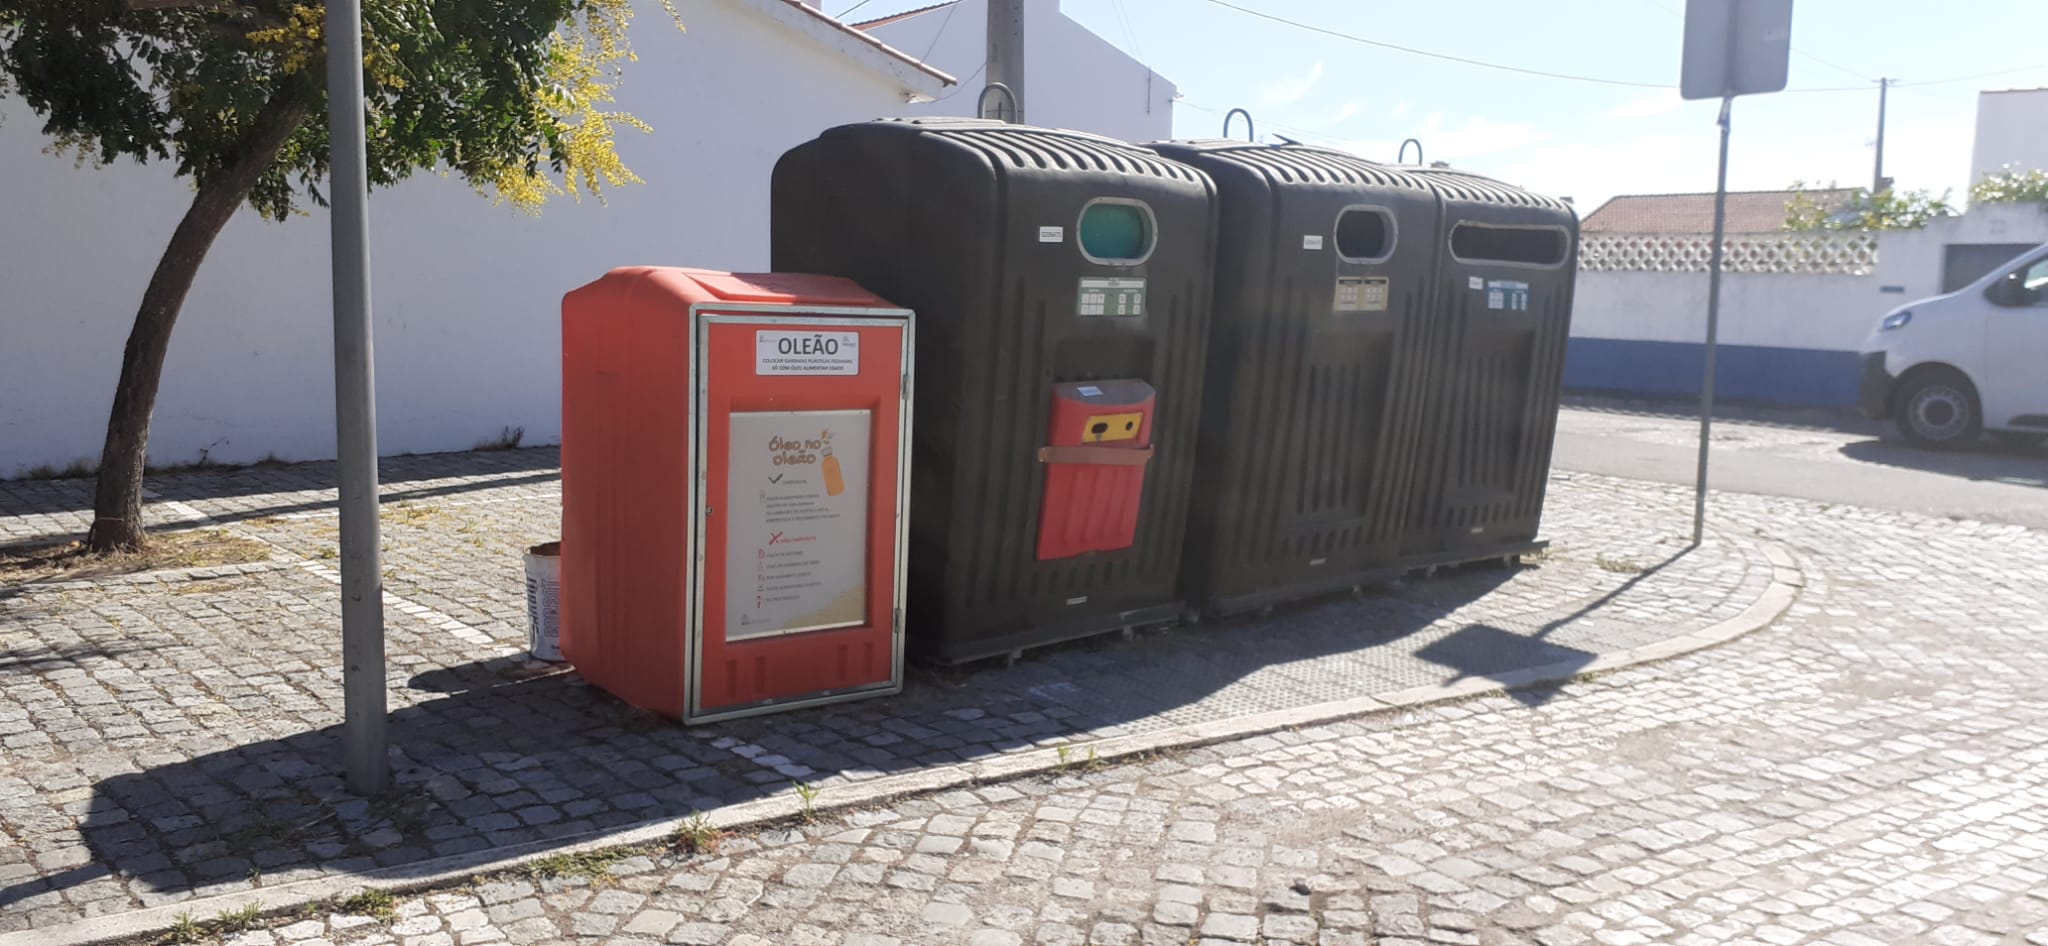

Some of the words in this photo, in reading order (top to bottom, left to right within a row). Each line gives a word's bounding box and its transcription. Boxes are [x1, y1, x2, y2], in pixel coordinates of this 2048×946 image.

[778, 334, 838, 355] OLEÃO
[768, 435, 801, 451] Óleo
[804, 440, 821, 449] no
[772, 449, 817, 466] oleão
